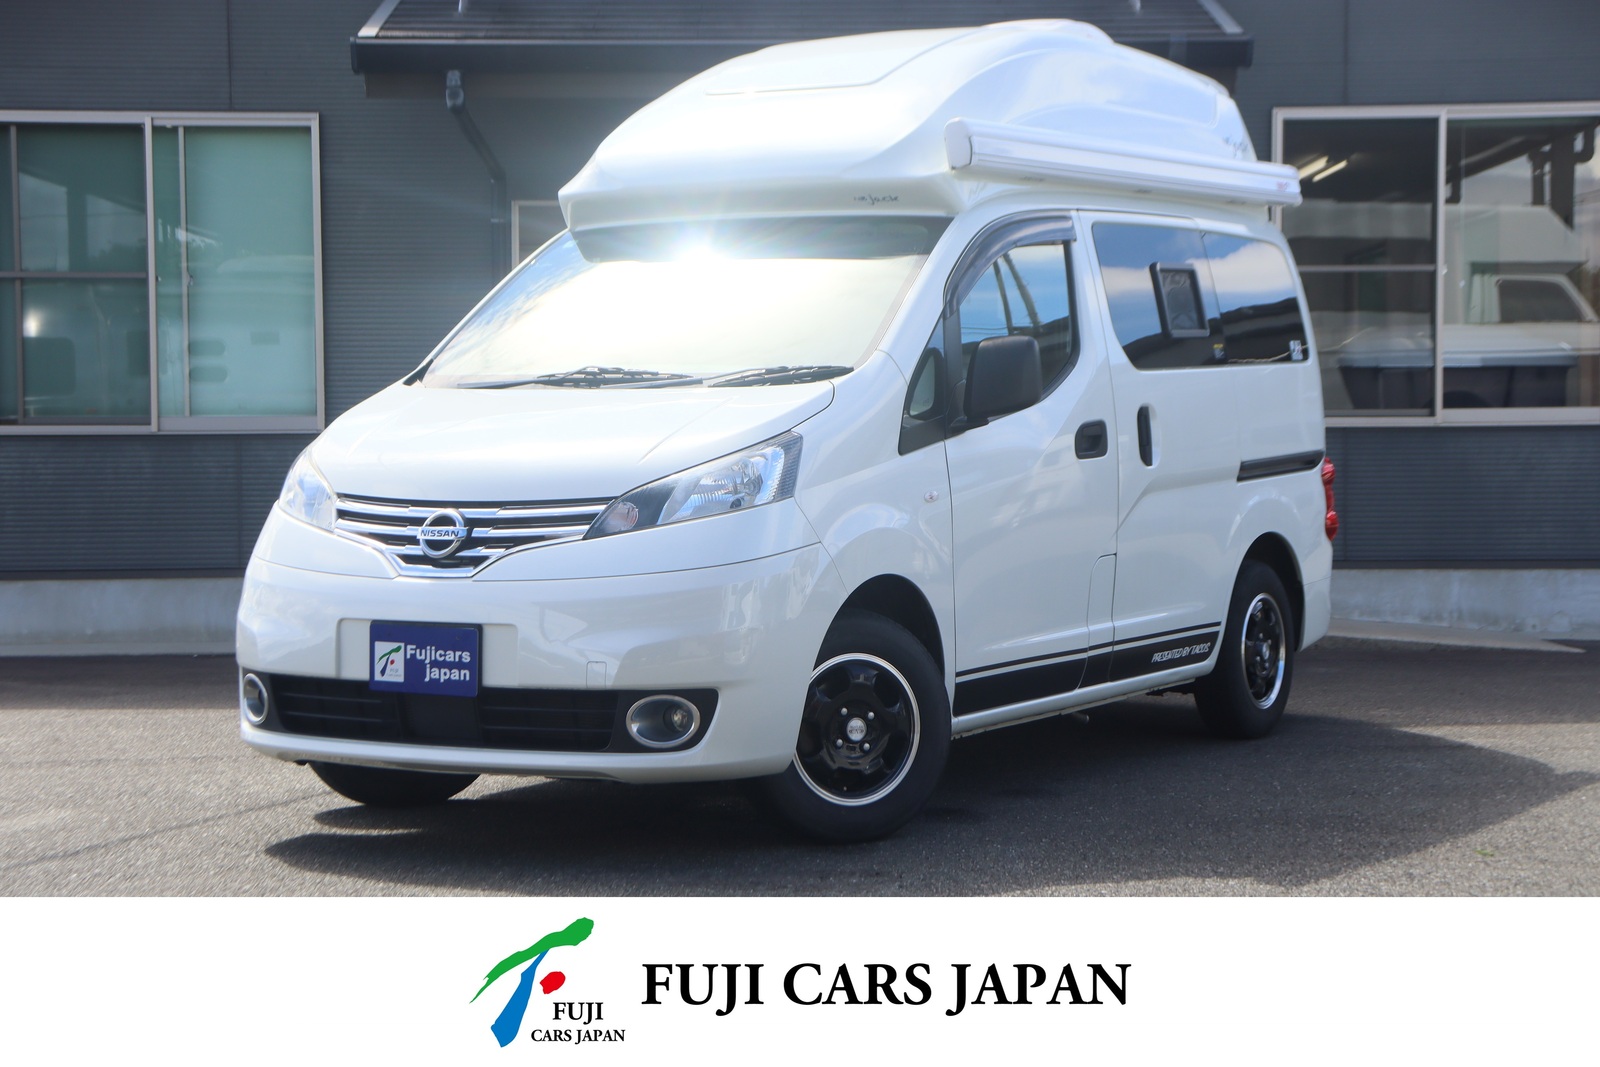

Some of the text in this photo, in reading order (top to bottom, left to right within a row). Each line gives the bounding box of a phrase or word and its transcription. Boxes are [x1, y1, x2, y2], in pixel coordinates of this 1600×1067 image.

[420, 529, 460, 538] NISSAN
[406, 644, 472, 664] Fujicars
[1151, 648, 1184, 663] PRESENTED
[1181, 646, 1192, 657] BY
[424, 664, 471, 683] japan
